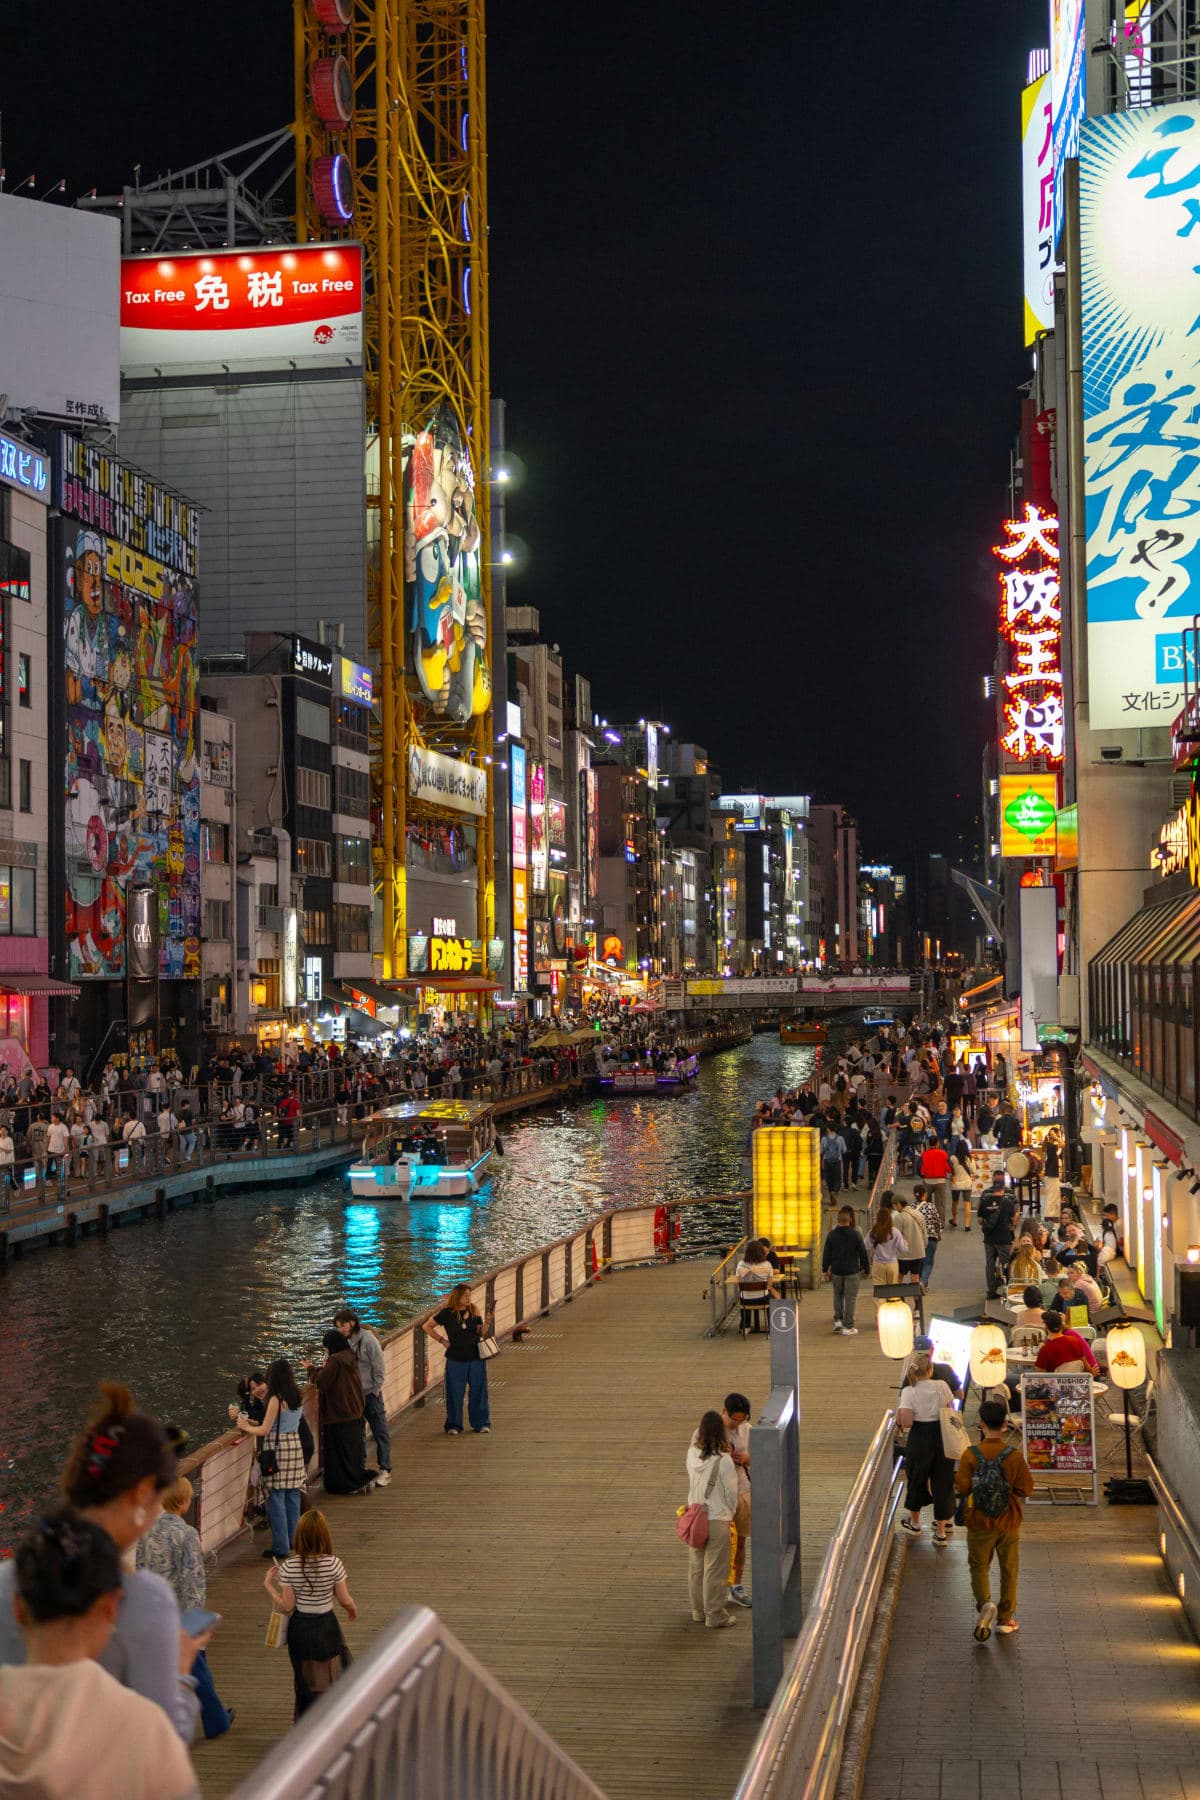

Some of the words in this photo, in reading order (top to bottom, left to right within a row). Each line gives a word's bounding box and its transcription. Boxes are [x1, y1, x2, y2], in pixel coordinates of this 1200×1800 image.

[125, 290, 150, 304] Tax
[155, 289, 186, 303] Free
[193, 271, 283, 312] 免税
[292, 281, 318, 294] Tax
[322, 278, 354, 292] Free
[105, 536, 165, 600] 2025
[995, 502, 1064, 761] 大阪王将
